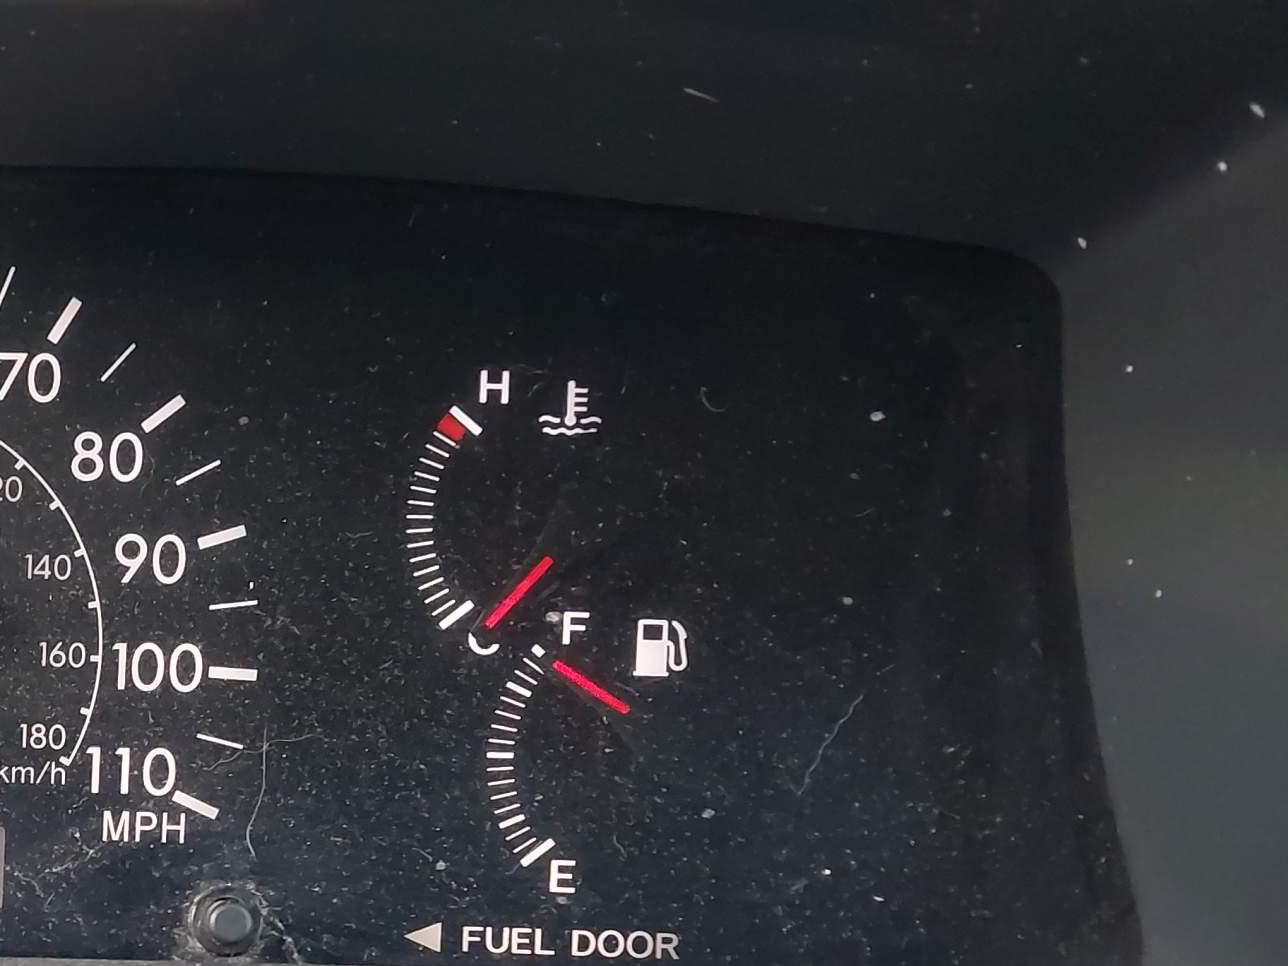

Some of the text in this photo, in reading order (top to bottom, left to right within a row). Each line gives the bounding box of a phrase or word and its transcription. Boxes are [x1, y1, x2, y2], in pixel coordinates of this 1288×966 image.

[479, 370, 509, 404] H
[71, 432, 143, 482] 80
[25, 554, 71, 580] 140
[115, 534, 186, 584] 90
[562, 612, 589, 644] F
[40, 642, 85, 668] 160
[116, 643, 202, 692] 100
[20, 724, 65, 749] 180
[86, 747, 175, 796] 110
[102, 809, 186, 844] MPH
[550, 860, 576, 893] E
[463, 927, 678, 959] FUEL DOOR
